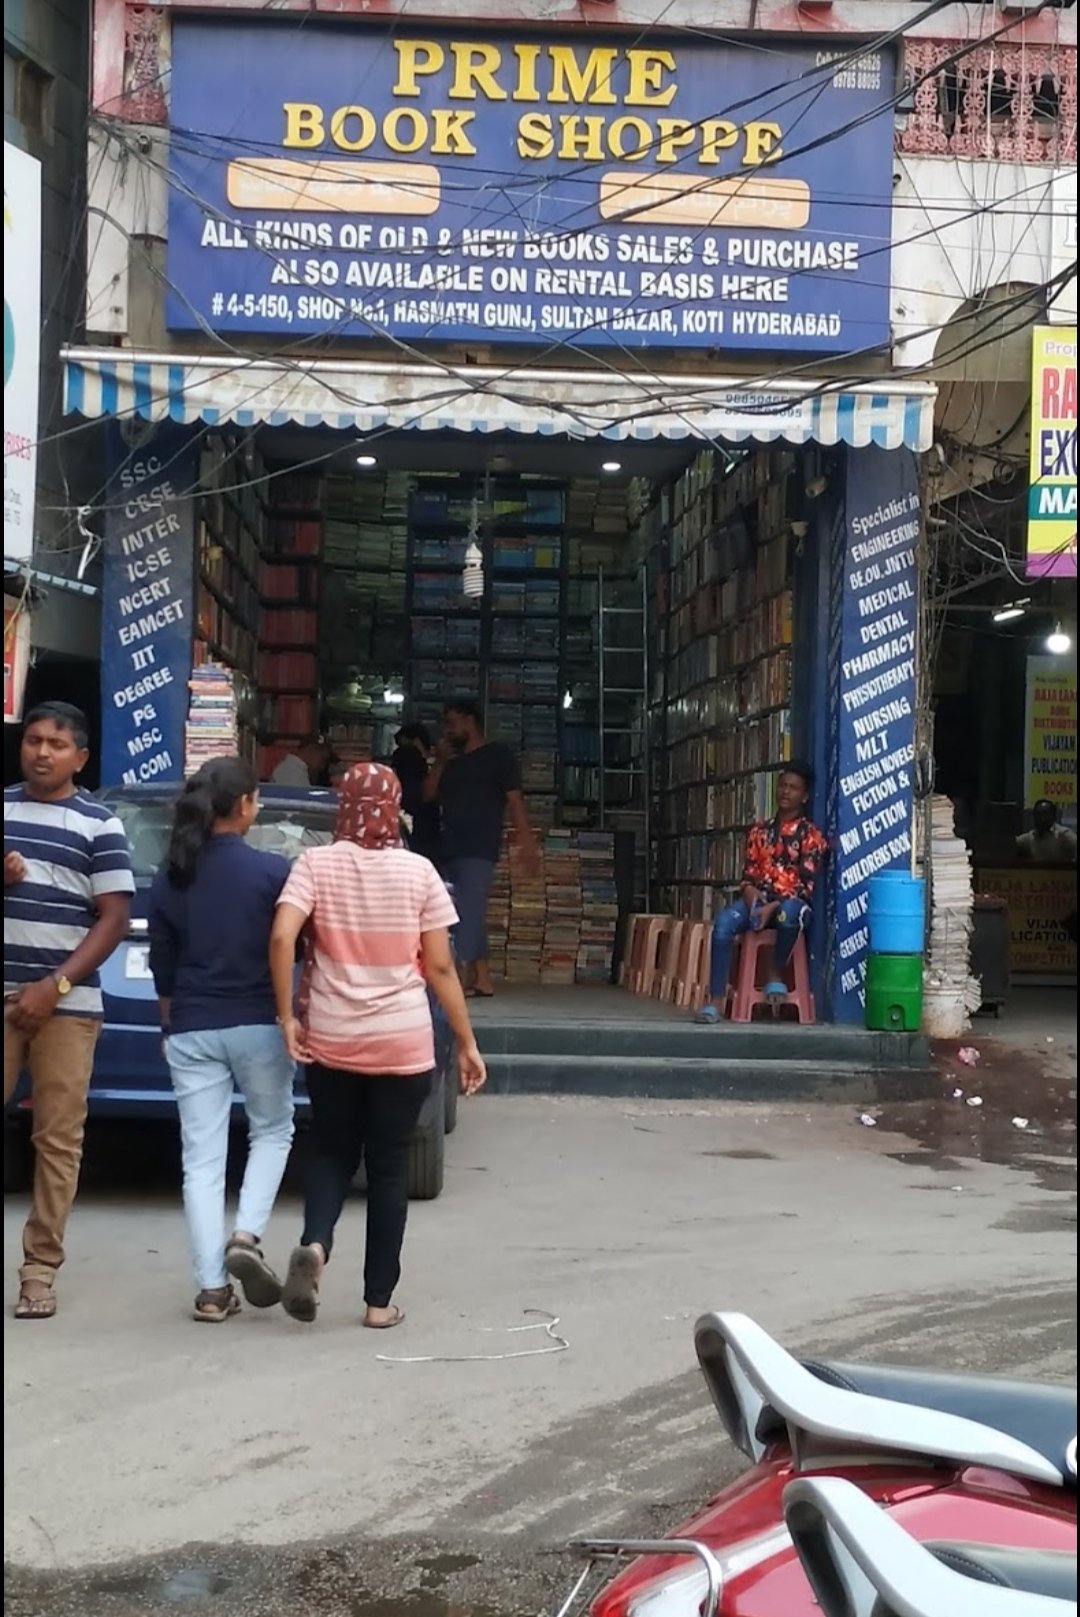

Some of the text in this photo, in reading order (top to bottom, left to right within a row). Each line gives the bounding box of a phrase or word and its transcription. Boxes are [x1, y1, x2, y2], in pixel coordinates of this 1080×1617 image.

[391, 39, 678, 107] PRIME
[283, 102, 785, 166] BOOK SHOPPE
[201, 219, 859, 270] ALL KINDS OF OLD & NEW BOOKS SALES & PURCHASE
[271, 259, 789, 302] ALSO AVAILABLE ON RENTAL BASIS HERE
[212, 292, 224, 316] #
[227, 293, 293, 324] 4-5-150,
[297, 296, 345, 321] SHOP
[394, 300, 479, 326] HASMATH
[484, 304, 537, 331] GUNJ,
[541, 304, 607, 331] SULTAN
[613, 309, 678, 337] BAZAR,
[683, 309, 722, 334] KOTI
[731, 310, 841, 337] HYDERABAD
[120, 456, 161, 488] SSC
[1040, 428, 1077, 477] EX
[125, 481, 177, 519] CBSE
[851, 491, 920, 536] Specialist in
[121, 513, 180, 556] INTER
[851, 520, 920, 564] ENGINEERING
[127, 546, 173, 582] ICSE
[119, 576, 171, 617] NCERT
[858, 580, 915, 617] MEDICAL
[118, 598, 184, 647] EAMCET
[860, 610, 909, 644] DENTAL
[131, 644, 157, 672] IIT
[842, 630, 915, 680] PHARMACY
[113, 666, 174, 709] DEGREE
[132, 703, 157, 728] PG
[853, 696, 912, 740] NURSING
[126, 727, 163, 757] MSC
[855, 730, 889, 763] MLT
[121, 749, 173, 785] M.COM
[840, 743, 916, 798] ENGLISH NOVELS
[852, 769, 911, 817] FICTION &
[840, 800, 908, 856] NON FICTION
[841, 846, 893, 892] CHILDRENS
